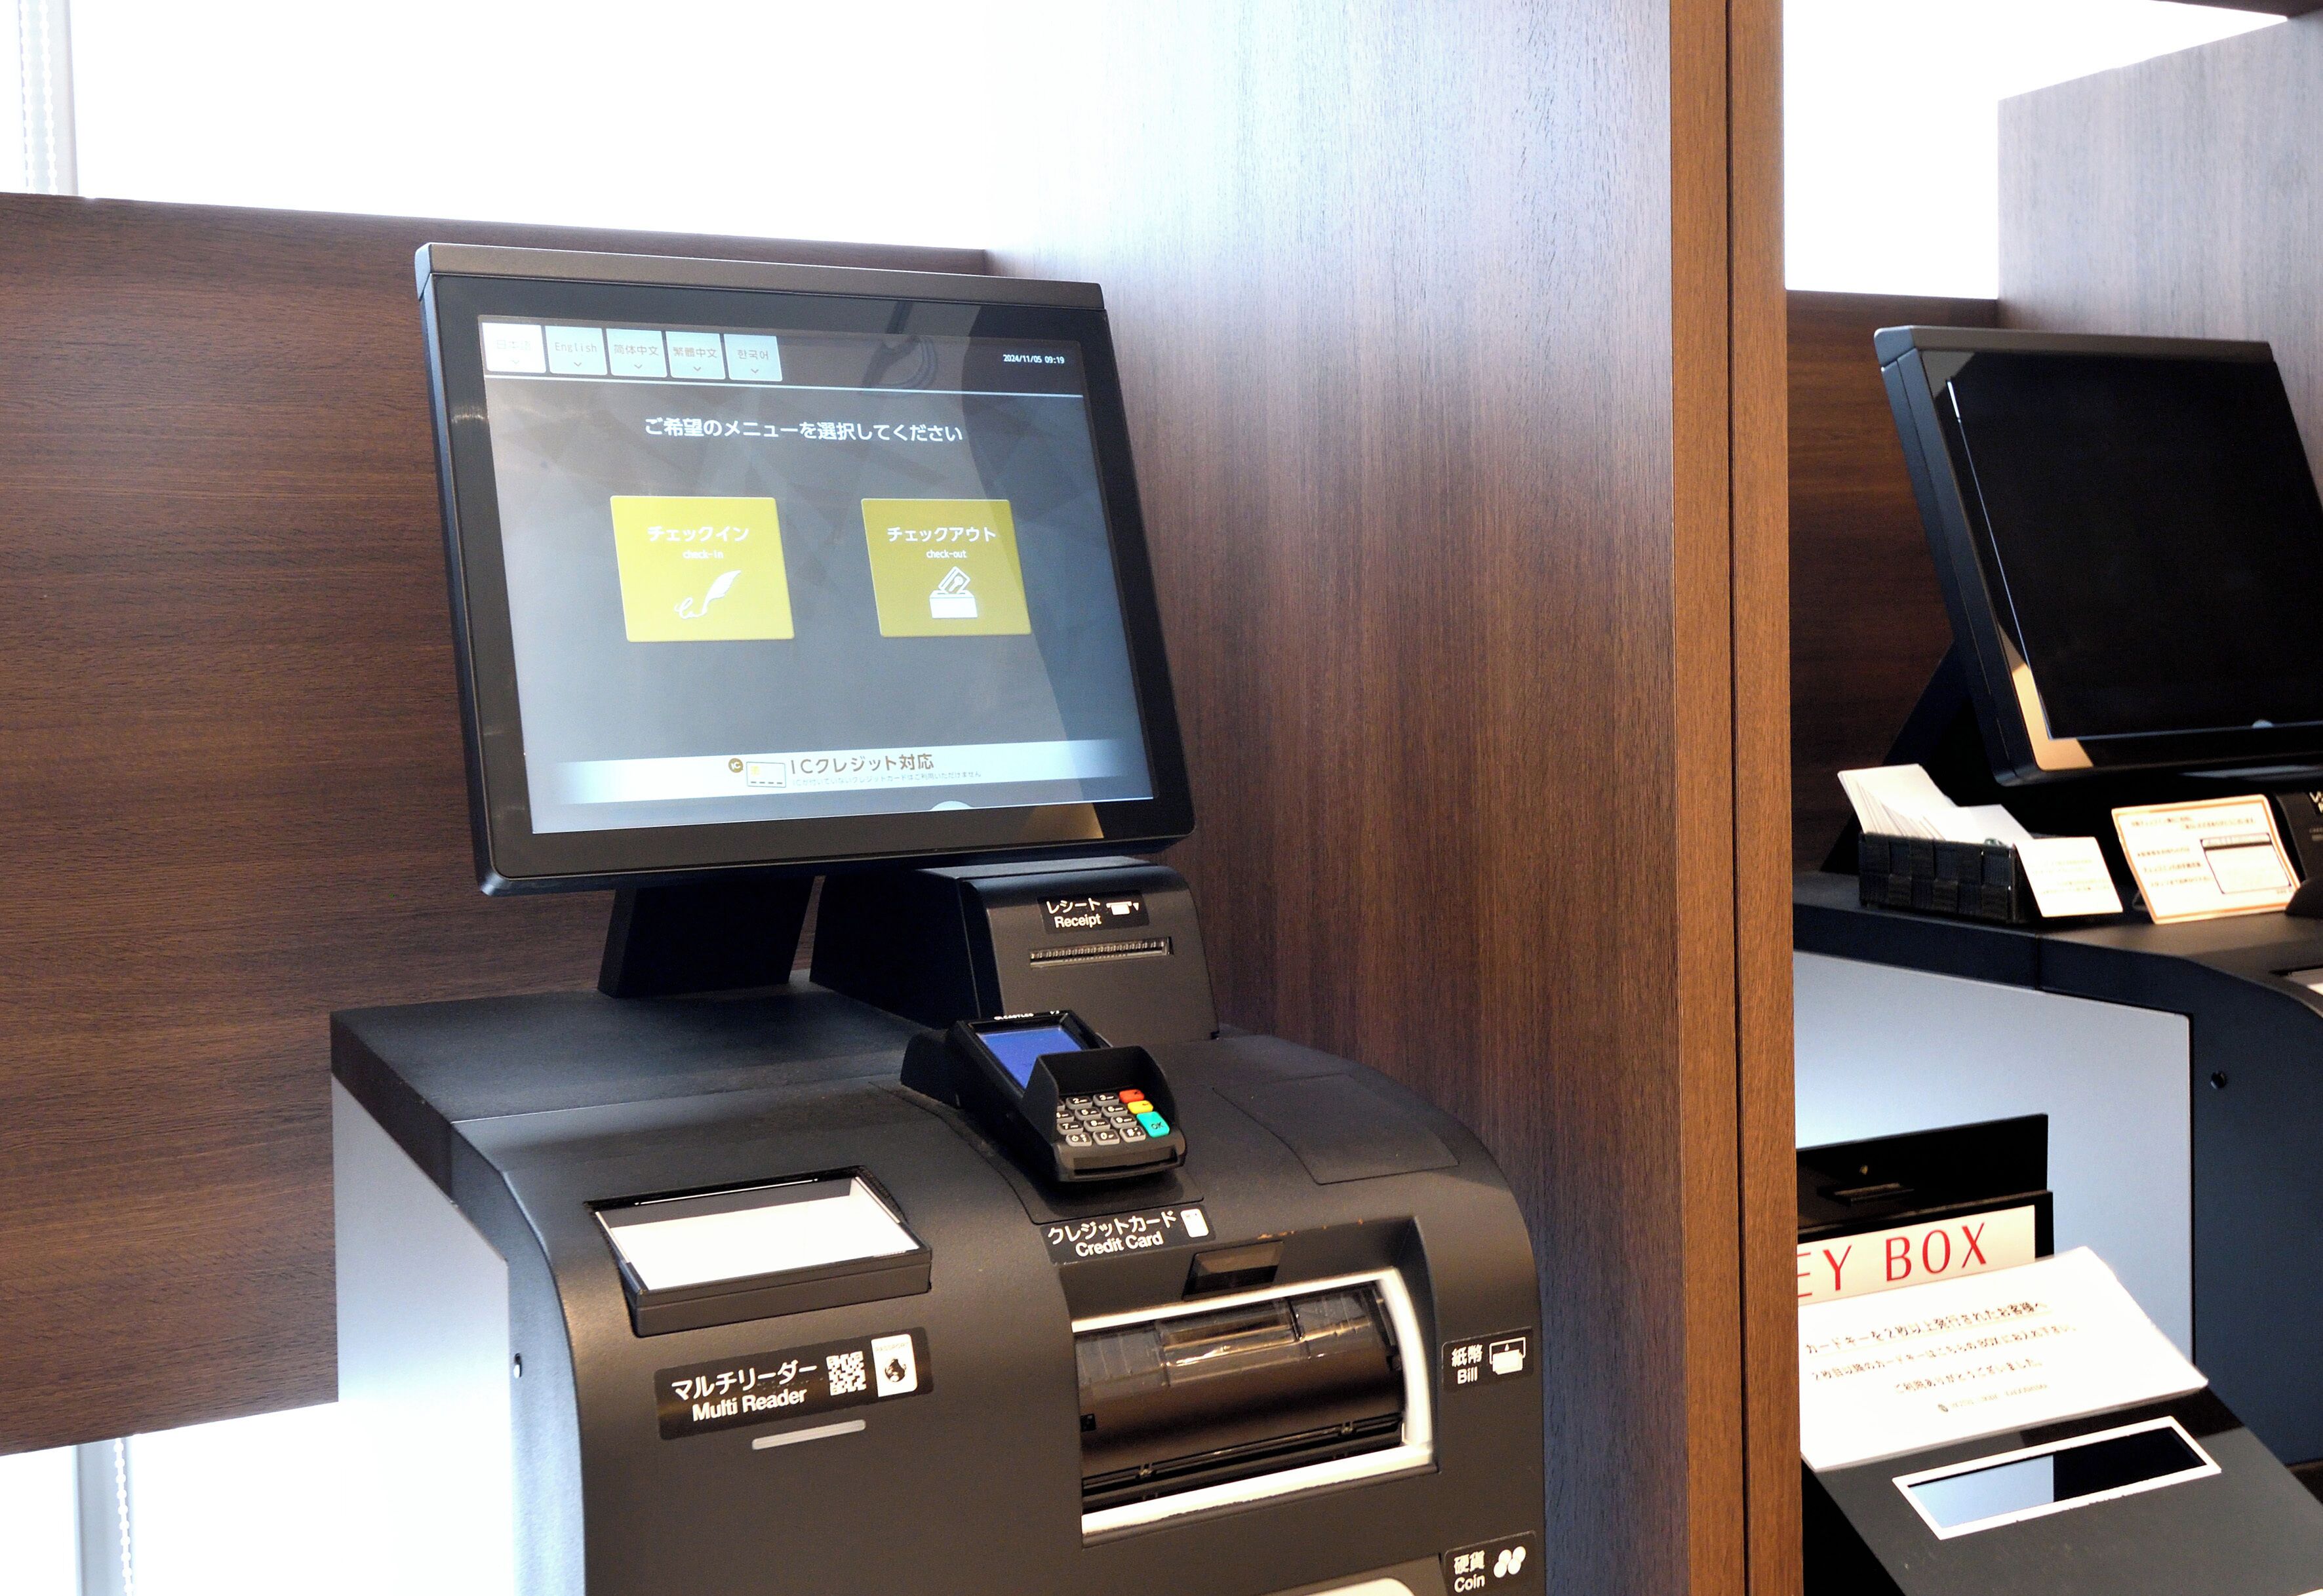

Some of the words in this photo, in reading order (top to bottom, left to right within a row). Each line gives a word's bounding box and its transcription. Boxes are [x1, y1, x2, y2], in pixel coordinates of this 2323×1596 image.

[555, 342, 597, 354] English
[614, 344, 659, 357] 简体中文
[737, 348, 770, 361] 한국어
[1003, 354, 1042, 363] 2024/11/05
[1044, 355, 1065, 364] 09:19
[645, 417, 963, 442] ご希望のメニューを選択してください
[647, 526, 749, 543] チェックイン
[886, 526, 997, 542] チェックアウト
[683, 548, 724, 560] check-in
[926, 548, 967, 559] check-out
[790, 753, 934, 775] ICクレジット対応
[1046, 898, 1101, 914] レシート
[1054, 913, 1102, 928] Receipt
[1048, 1210, 1177, 1245] クレジットカード
[1075, 1237, 1124, 1257] Credit
[1125, 1231, 1164, 1249] Card
[1885, 1222, 1987, 1283] BOX
[1451, 1344, 1483, 1367] 紙幣
[671, 1359, 818, 1402] マルチリーダー
[1457, 1366, 1478, 1385] Bill
[692, 1399, 738, 1422] Multi
[742, 1389, 807, 1412] Reader
[1453, 1550, 1485, 1575] 硬貨
[1454, 1574, 1485, 1593] Coin
